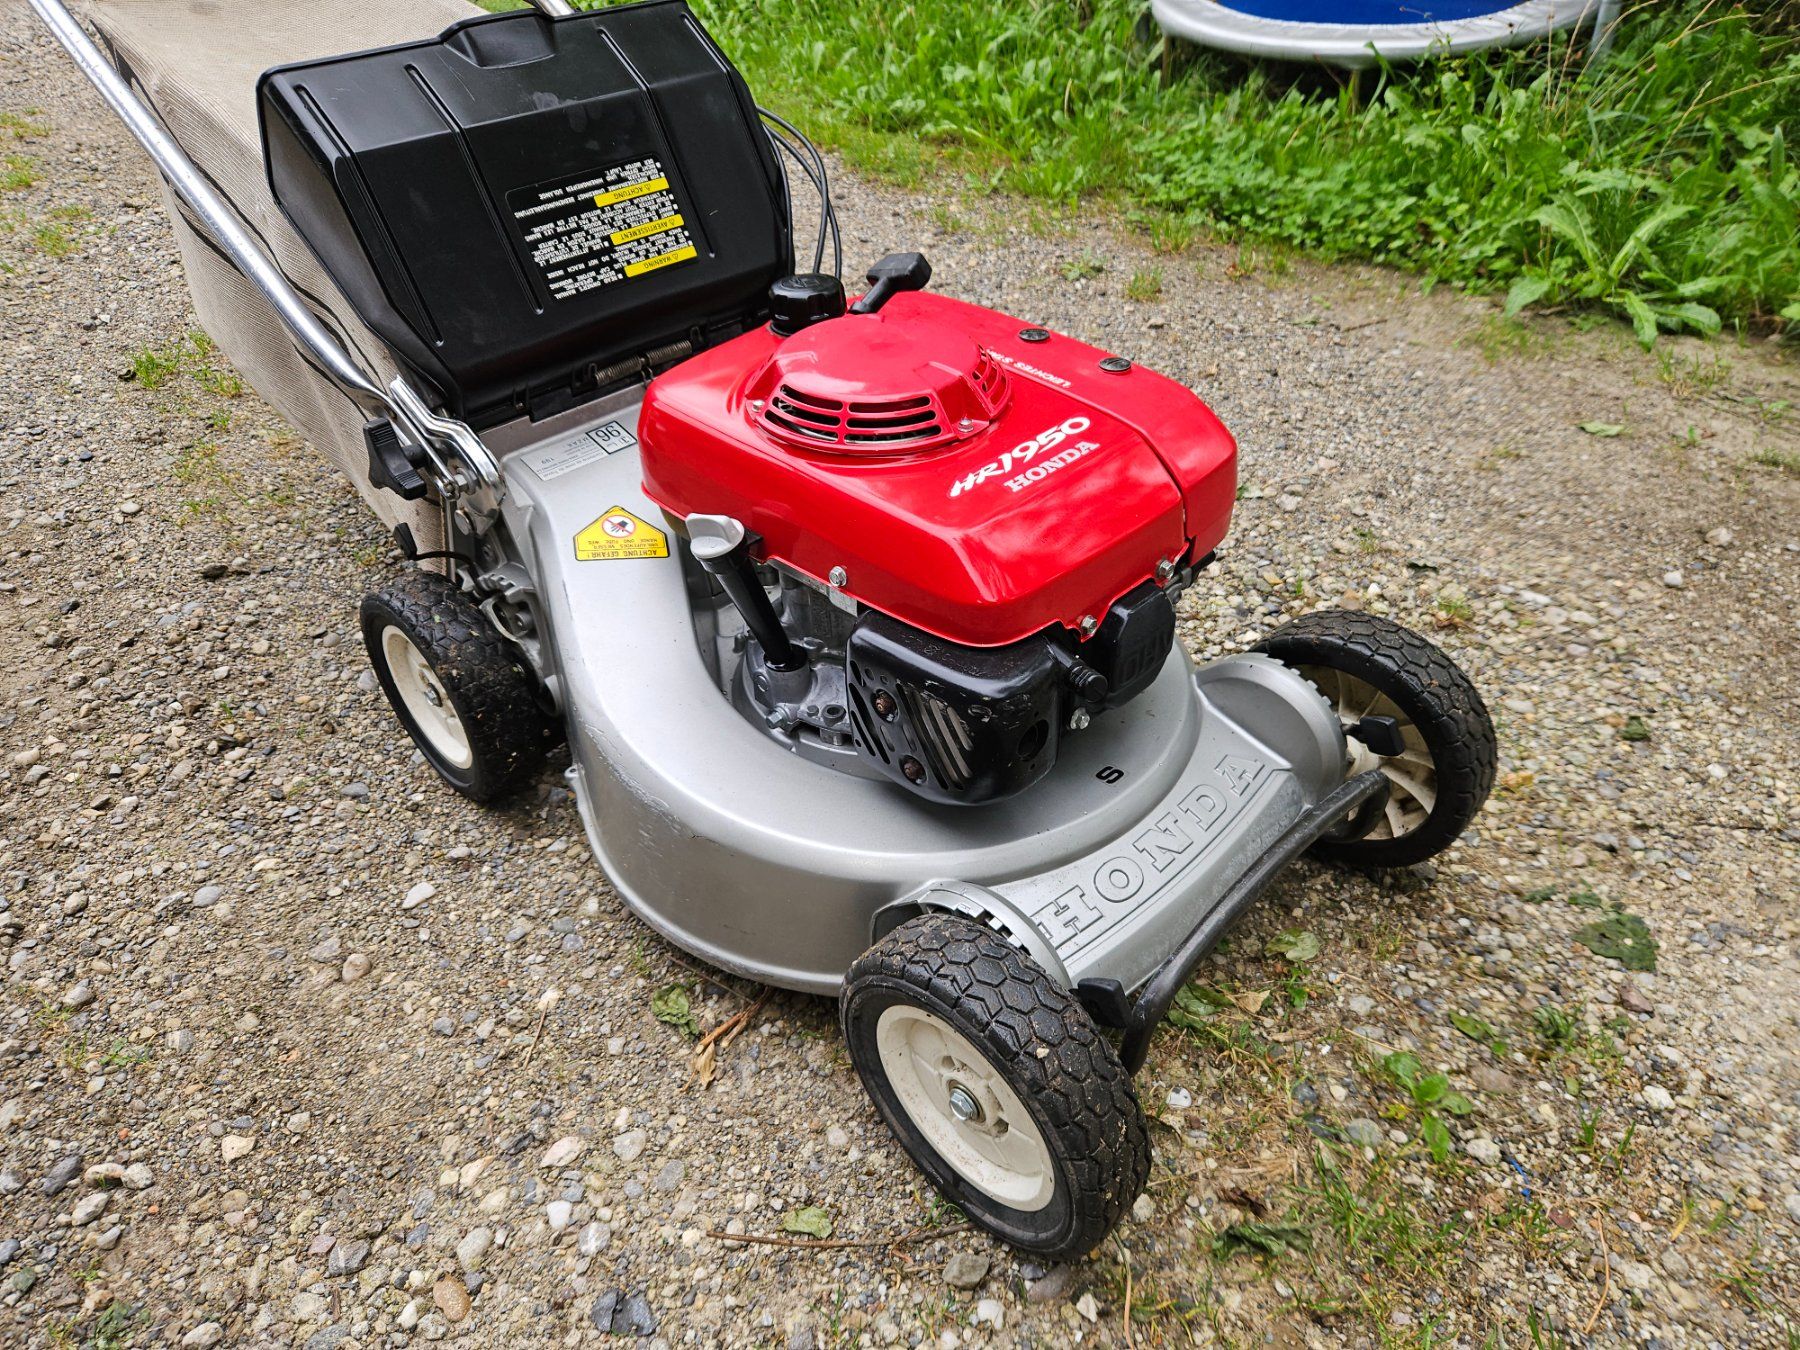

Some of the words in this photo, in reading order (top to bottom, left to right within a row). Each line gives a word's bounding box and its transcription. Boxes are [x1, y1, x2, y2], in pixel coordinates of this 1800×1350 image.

[613, 186, 644, 200] ACHTUNG
[619, 221, 668, 241] AVERTISSEMENT
[567, 263, 585, 273] REACH
[643, 256, 672, 269] WARNING
[576, 271, 596, 281] BEFORE
[599, 266, 611, 274] CAP
[549, 278, 574, 290] WORKING
[595, 425, 621, 442] 96
[950, 416, 1091, 498] HR1950
[1003, 441, 1101, 492] HONDA
[623, 549, 657, 557] ACHTUNG
[1095, 765, 1125, 785] S
[1030, 754, 1265, 950] HONDA
